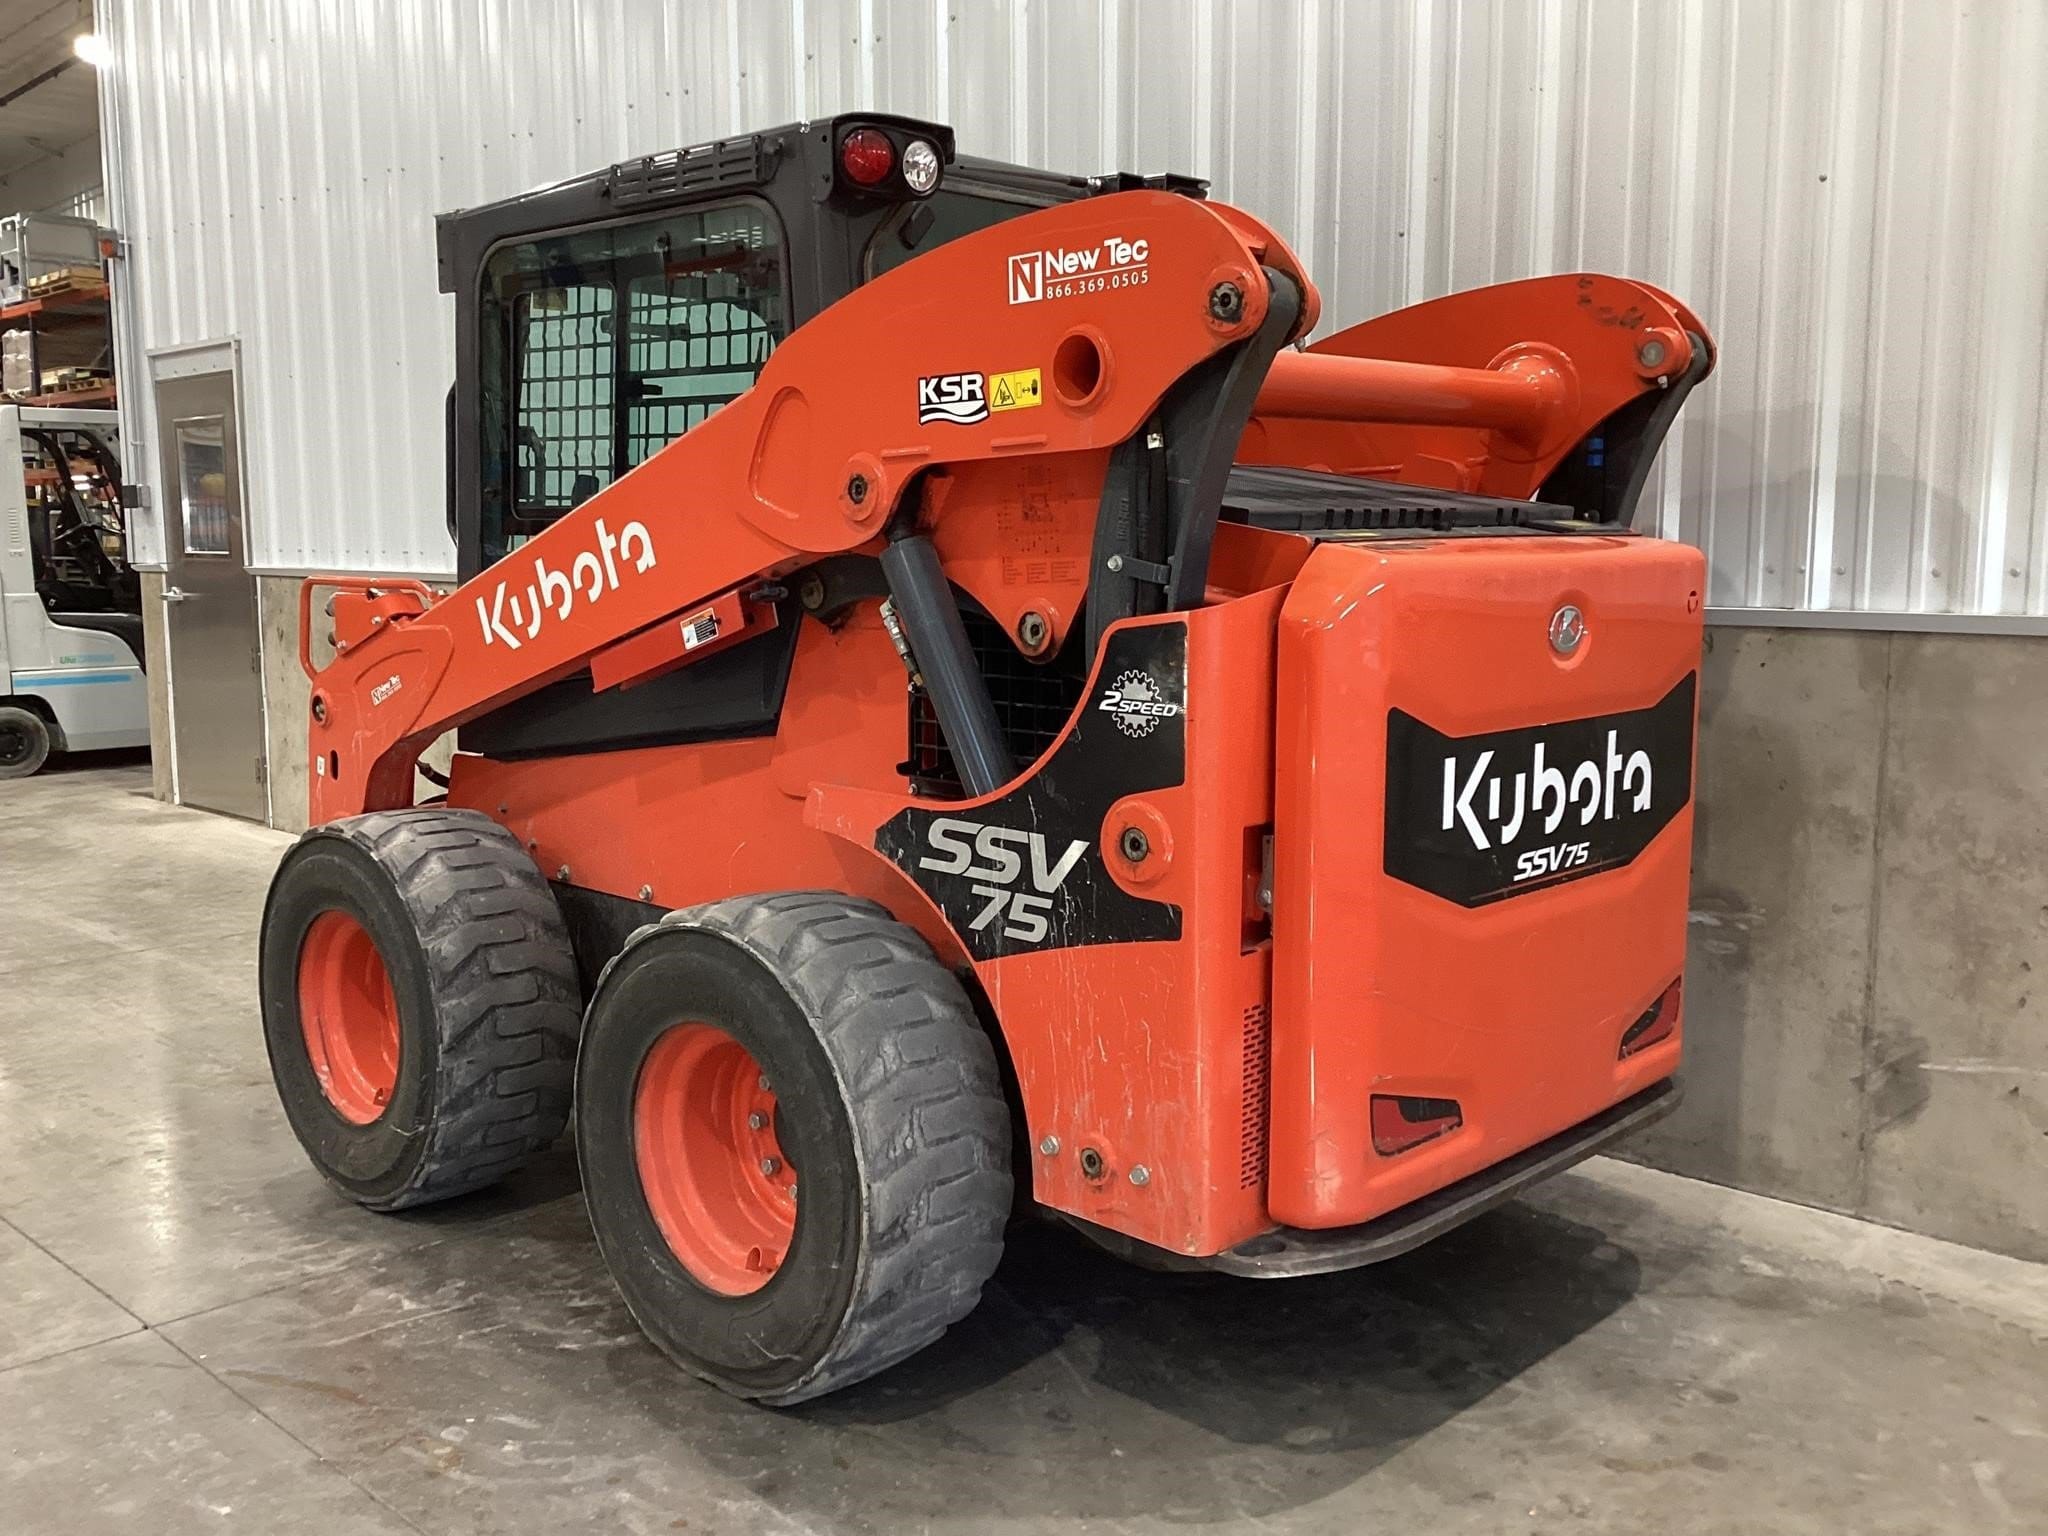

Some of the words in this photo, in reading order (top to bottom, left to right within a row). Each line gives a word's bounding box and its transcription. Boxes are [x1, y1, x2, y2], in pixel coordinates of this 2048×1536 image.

[1045, 248, 1100, 277] New
[1104, 237, 1149, 266] Tec
[1046, 270, 1148, 299] 866.369.0505
[920, 375, 983, 404] KSR
[477, 518, 656, 649] Kubota
[1443, 730, 1652, 850] Kubota
[920, 818, 1090, 893] SSV
[969, 886, 1053, 943] 75
